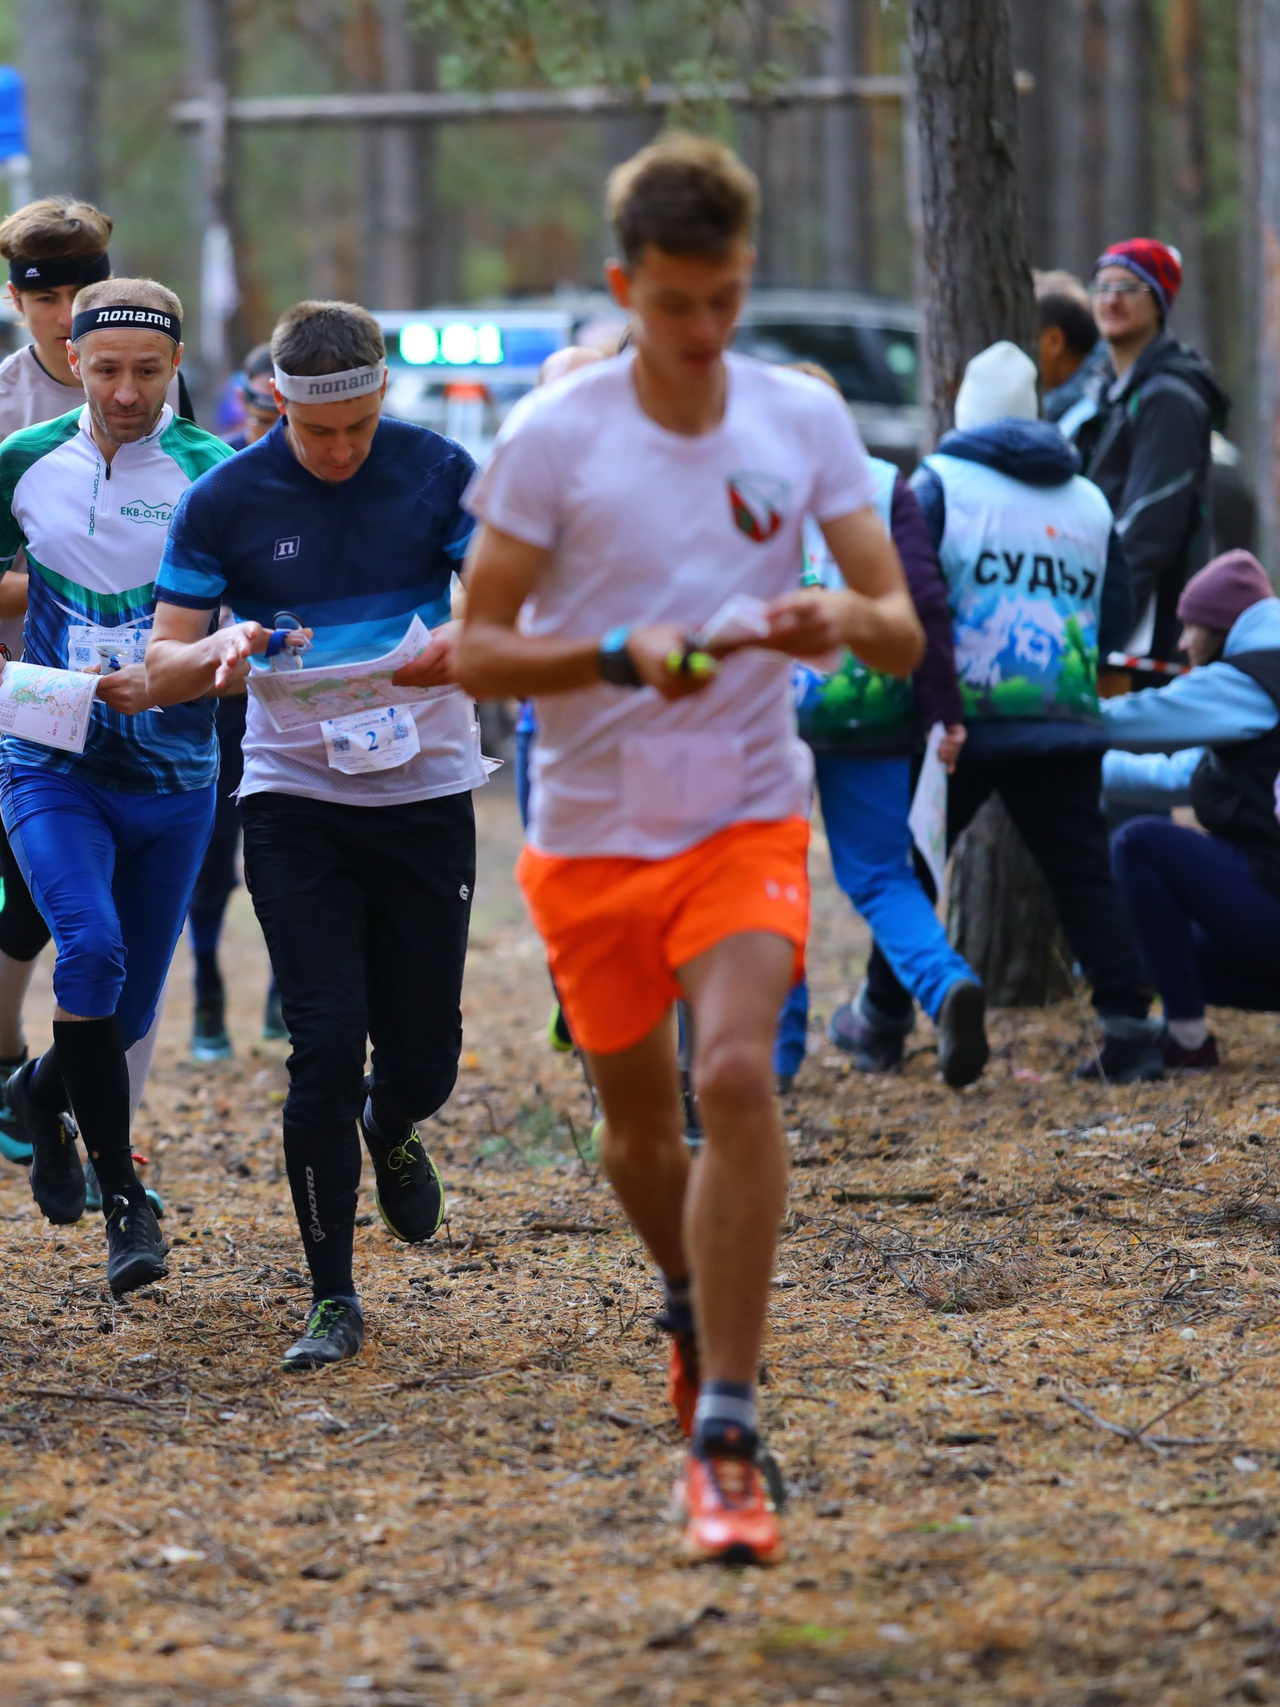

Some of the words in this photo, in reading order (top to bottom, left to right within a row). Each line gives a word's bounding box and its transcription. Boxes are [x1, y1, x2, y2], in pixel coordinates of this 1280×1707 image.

[96, 310, 171, 329] noname
[307, 370, 380, 395] noname
[88, 505, 96, 537] CODE
[120, 506, 173, 520] EKB-O-TEA
[365, 730, 379, 752] 2
[306, 1165, 320, 1223] NORD
